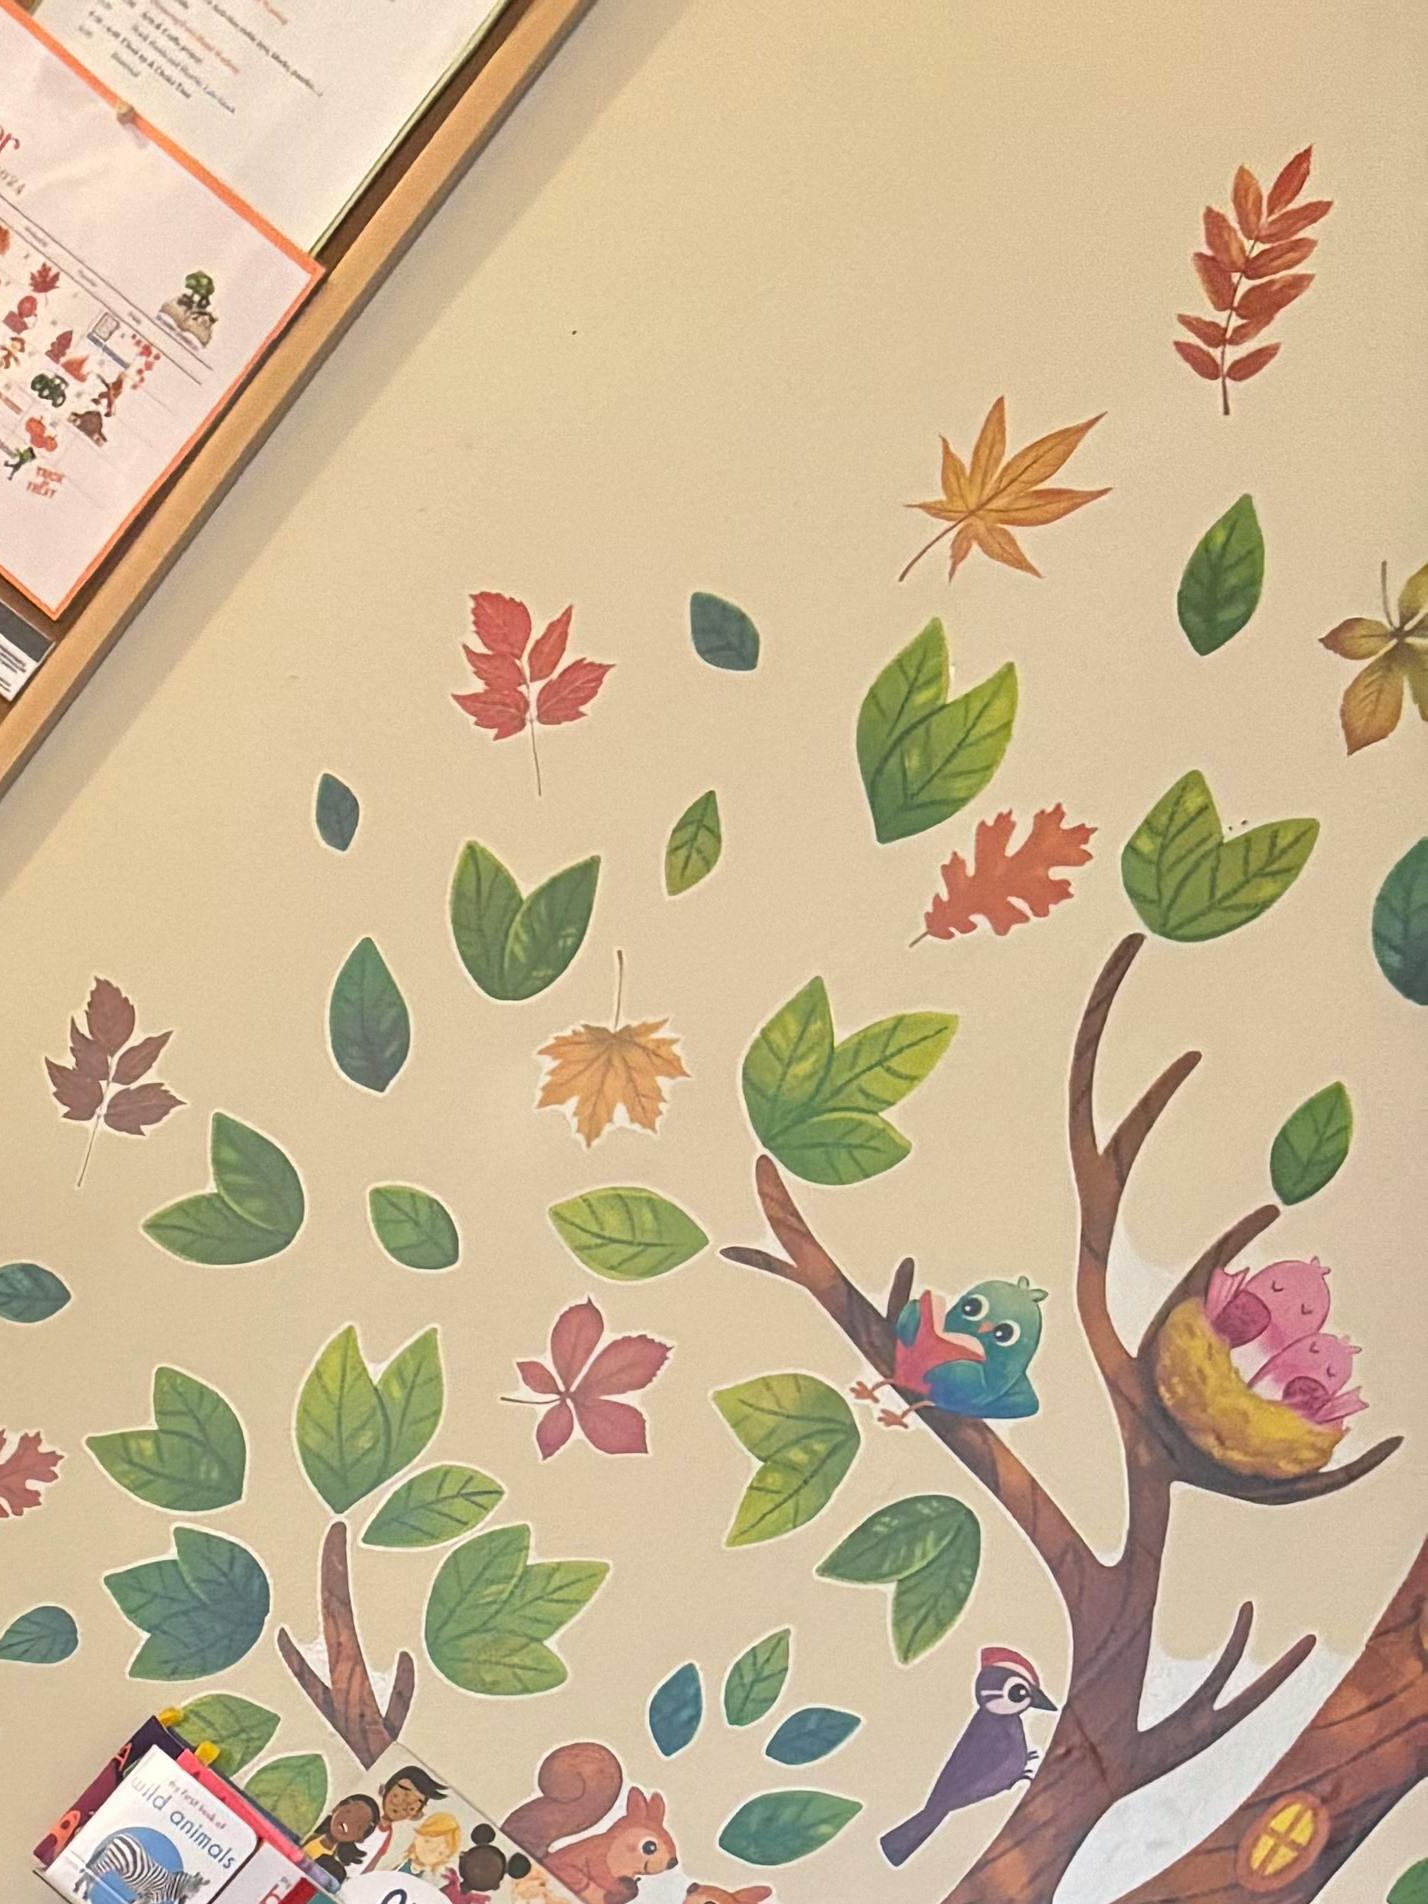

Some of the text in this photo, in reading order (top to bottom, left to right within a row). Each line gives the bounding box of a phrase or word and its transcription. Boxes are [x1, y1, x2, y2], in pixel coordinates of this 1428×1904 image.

[128, 1775, 235, 1869] wild animals
[178, 1789, 200, 1809] first
